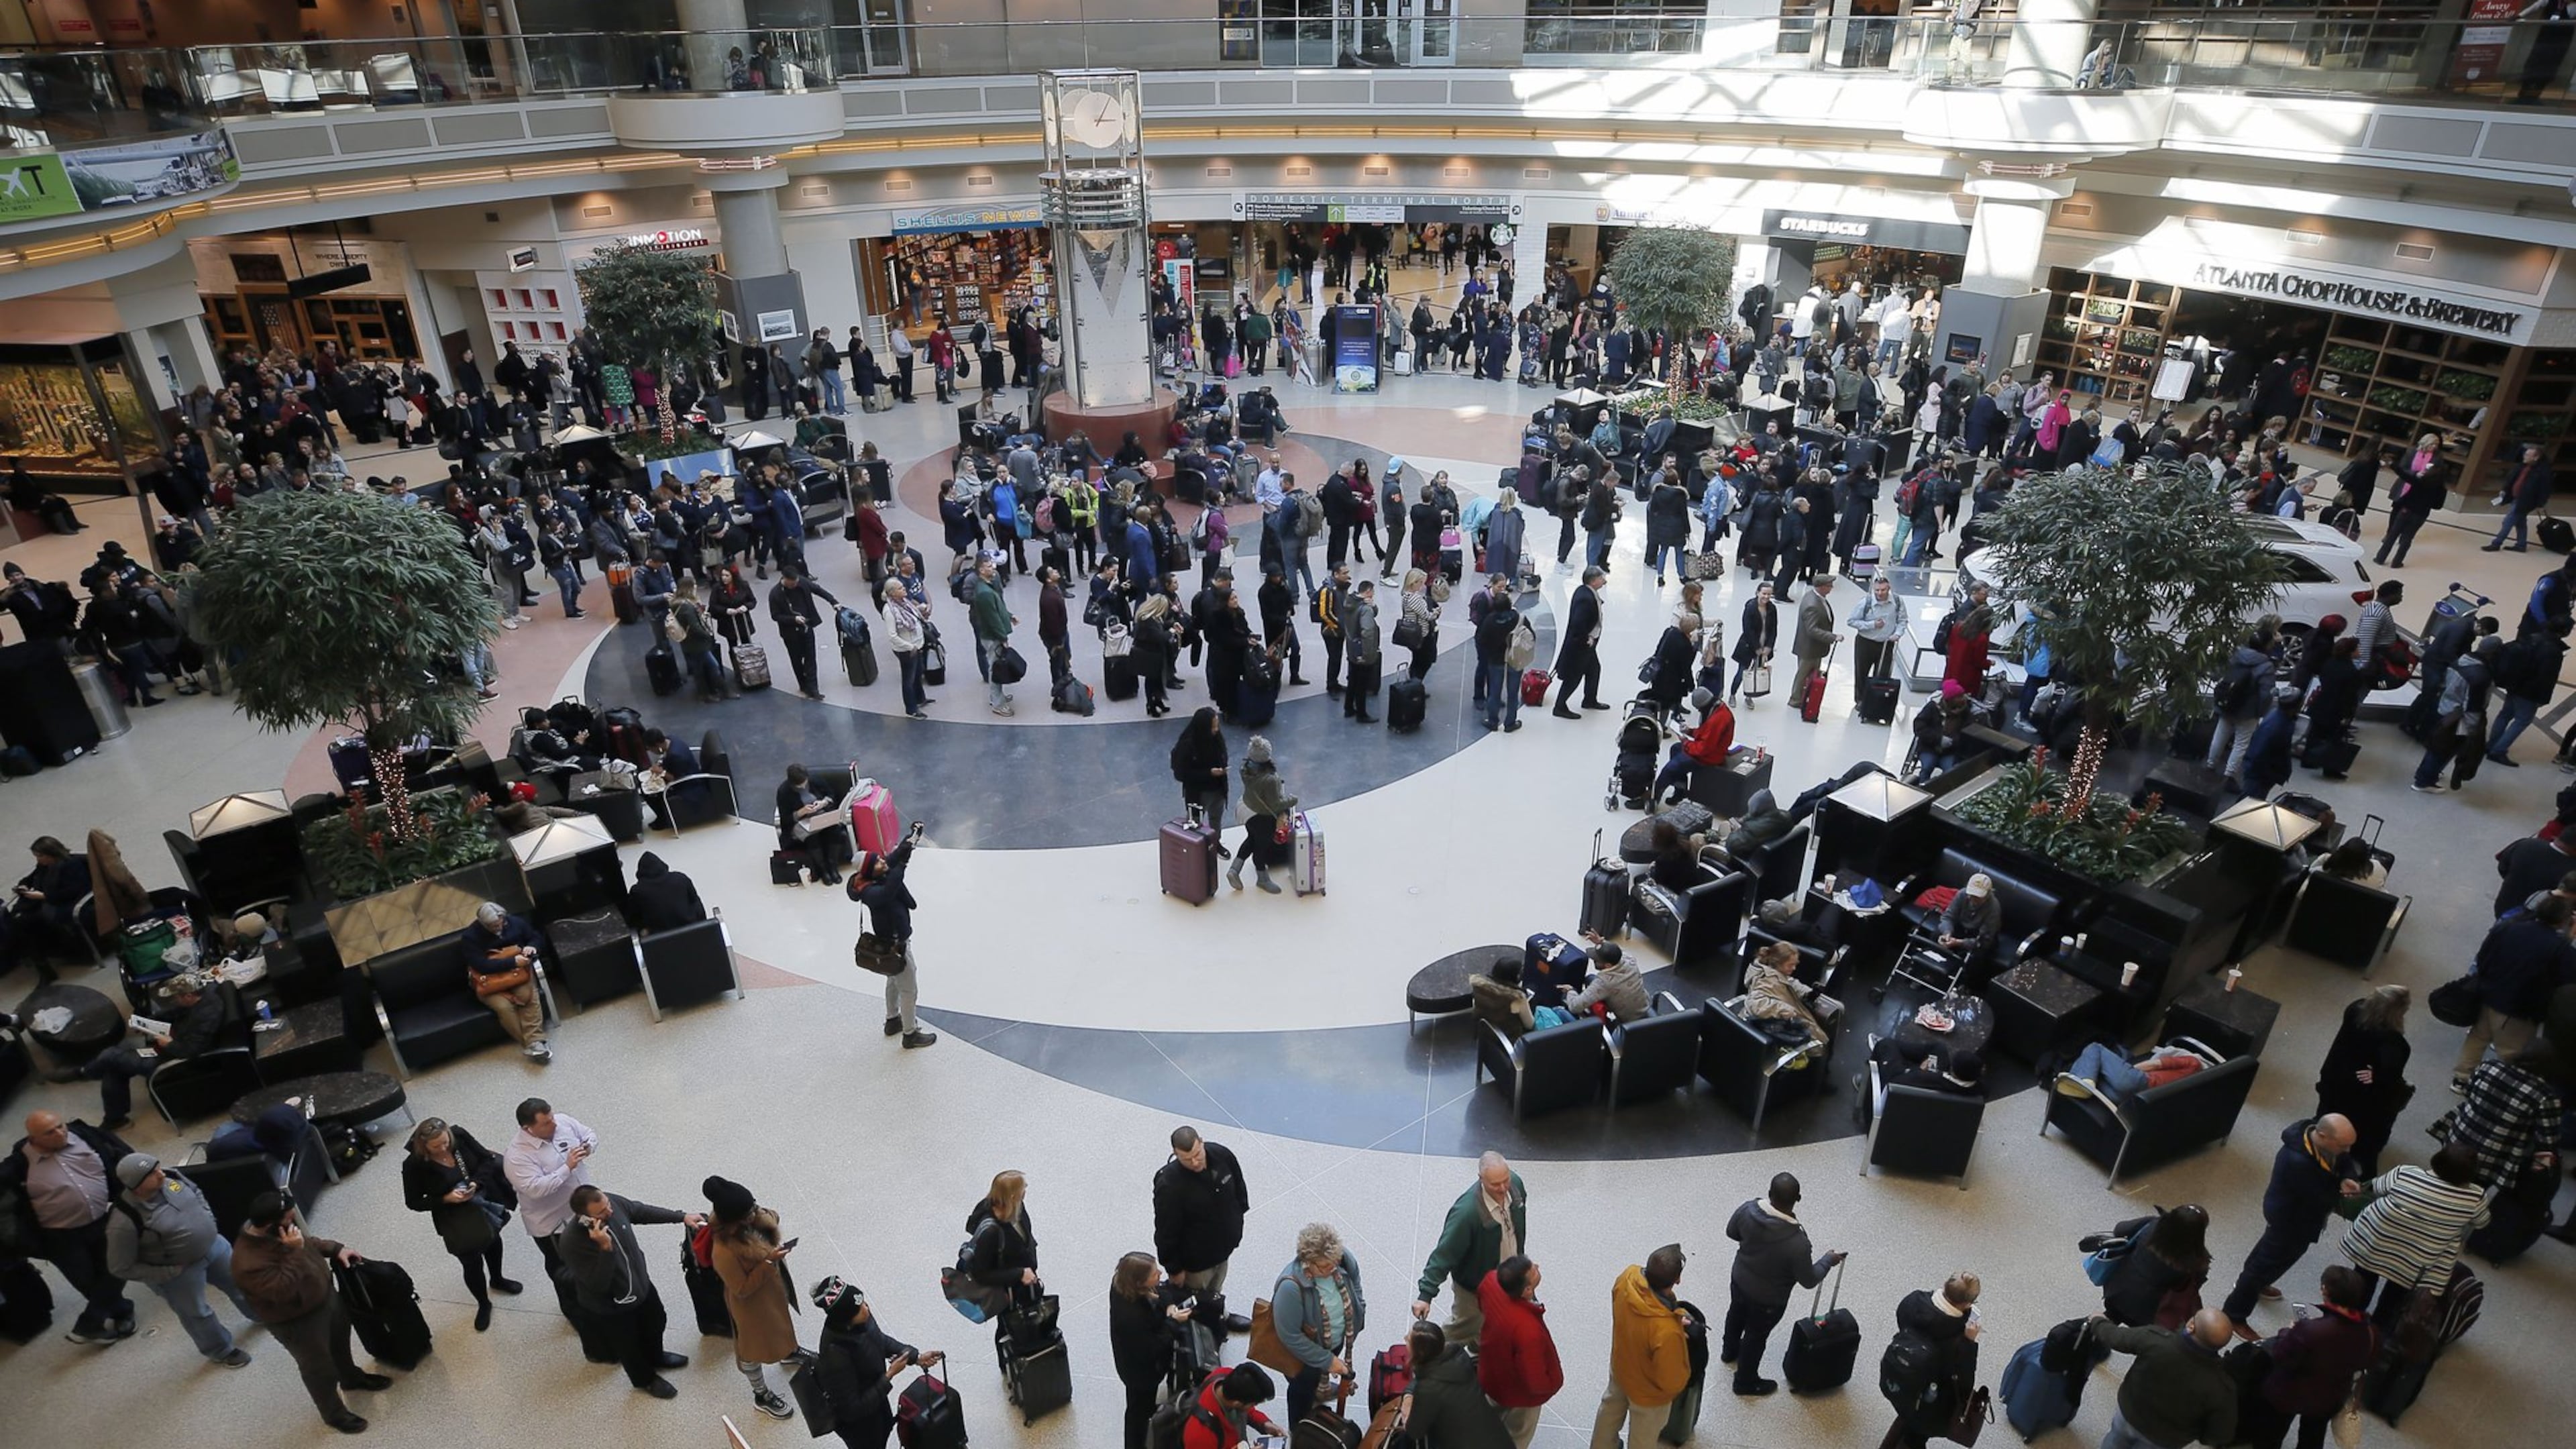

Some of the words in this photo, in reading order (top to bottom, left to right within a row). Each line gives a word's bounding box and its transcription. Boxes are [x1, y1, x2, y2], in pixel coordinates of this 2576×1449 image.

[2481, 2, 2510, 12] Away
[1250, 195, 1337, 203] DOMESTIC
[1350, 196, 1437, 205] TERMINAL
[1451, 197, 1507, 205] NORTH
[981, 209, 1038, 223] NEWS
[1780, 217, 1870, 237] STARBUCKS
[2194, 263, 2279, 293] ATLANTA
[2282, 275, 2406, 313] CHOPHOUSE
[2423, 298, 2521, 335] BREWERY
